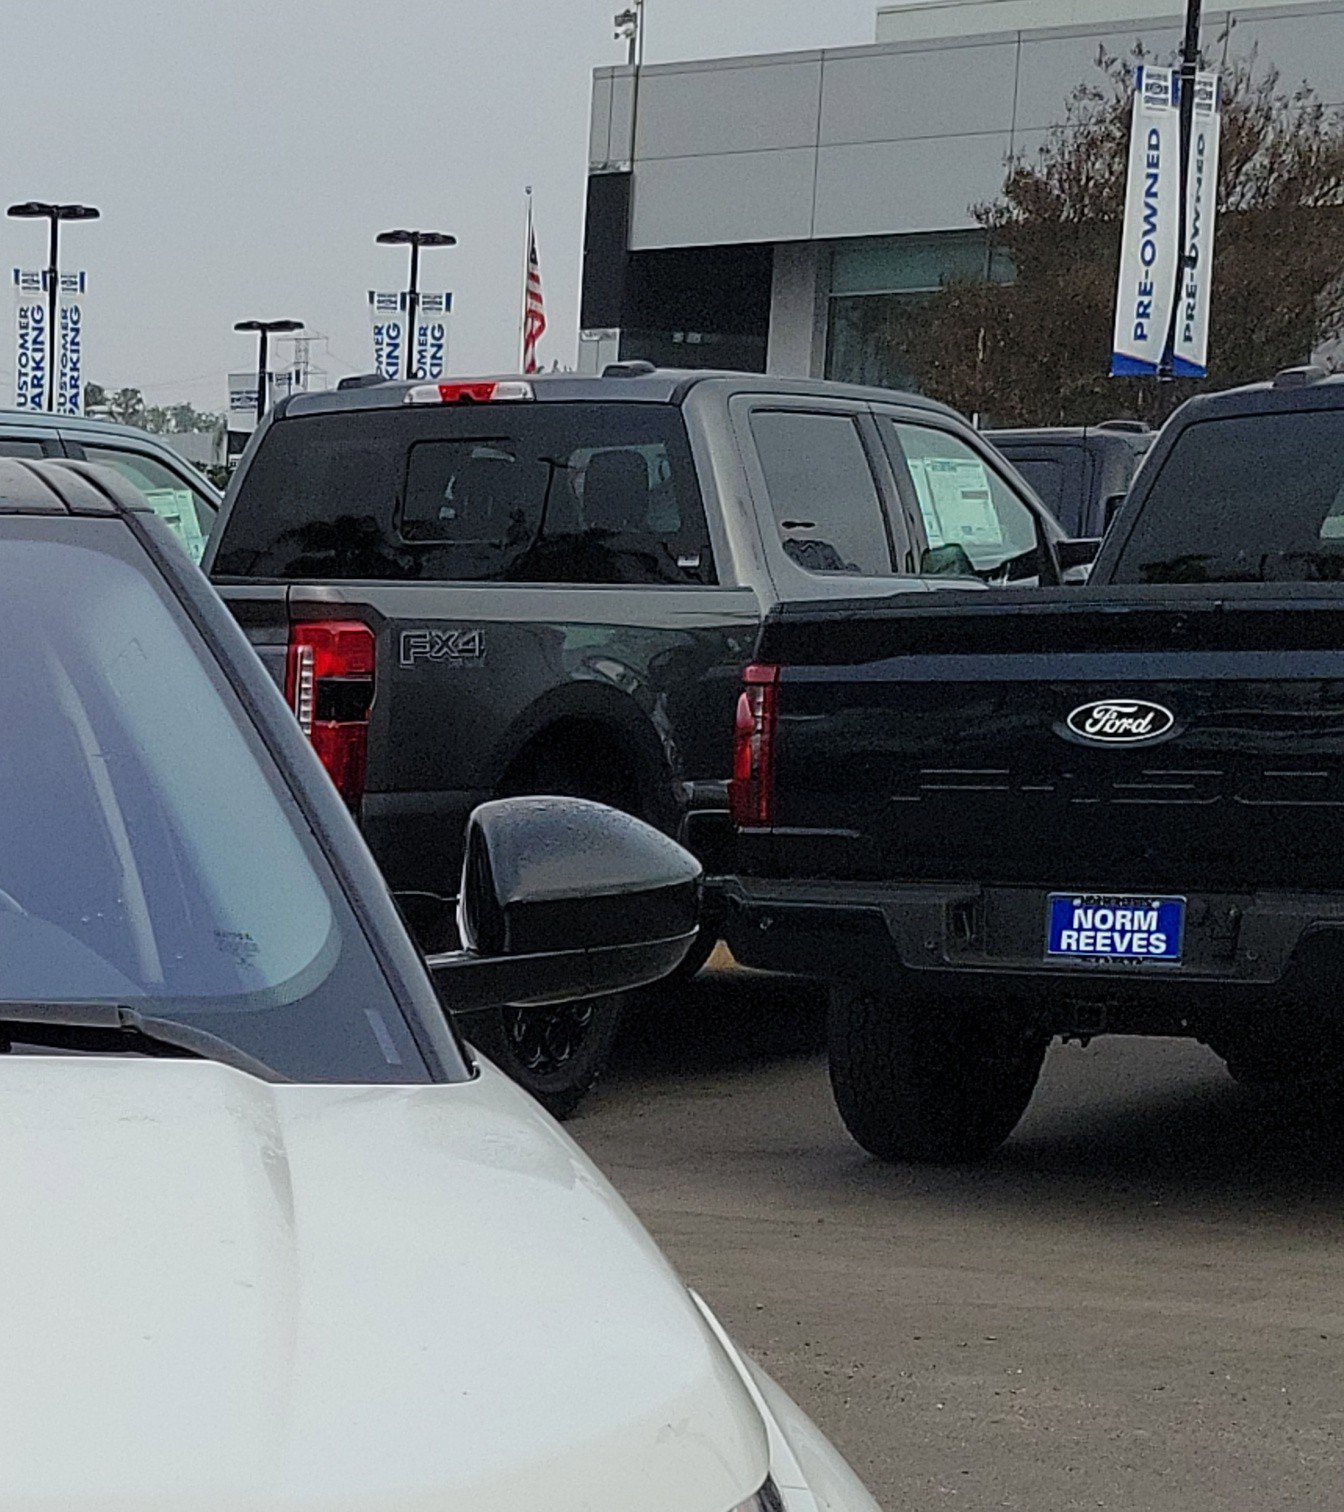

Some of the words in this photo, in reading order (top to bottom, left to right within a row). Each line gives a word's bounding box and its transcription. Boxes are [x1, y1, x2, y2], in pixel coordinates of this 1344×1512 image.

[1134, 127, 1161, 342] PRE-OWNED
[16, 306, 29, 407] USTOMER
[30, 305, 44, 410] ARKING
[385, 323, 400, 380] KING
[417, 326, 428, 380] OMER
[430, 324, 444, 379] KING
[400, 631, 484, 665] FX4
[1085, 705, 1155, 733] Ford
[1060, 930, 1167, 954] REEVES
[1073, 909, 1158, 931] NORM
